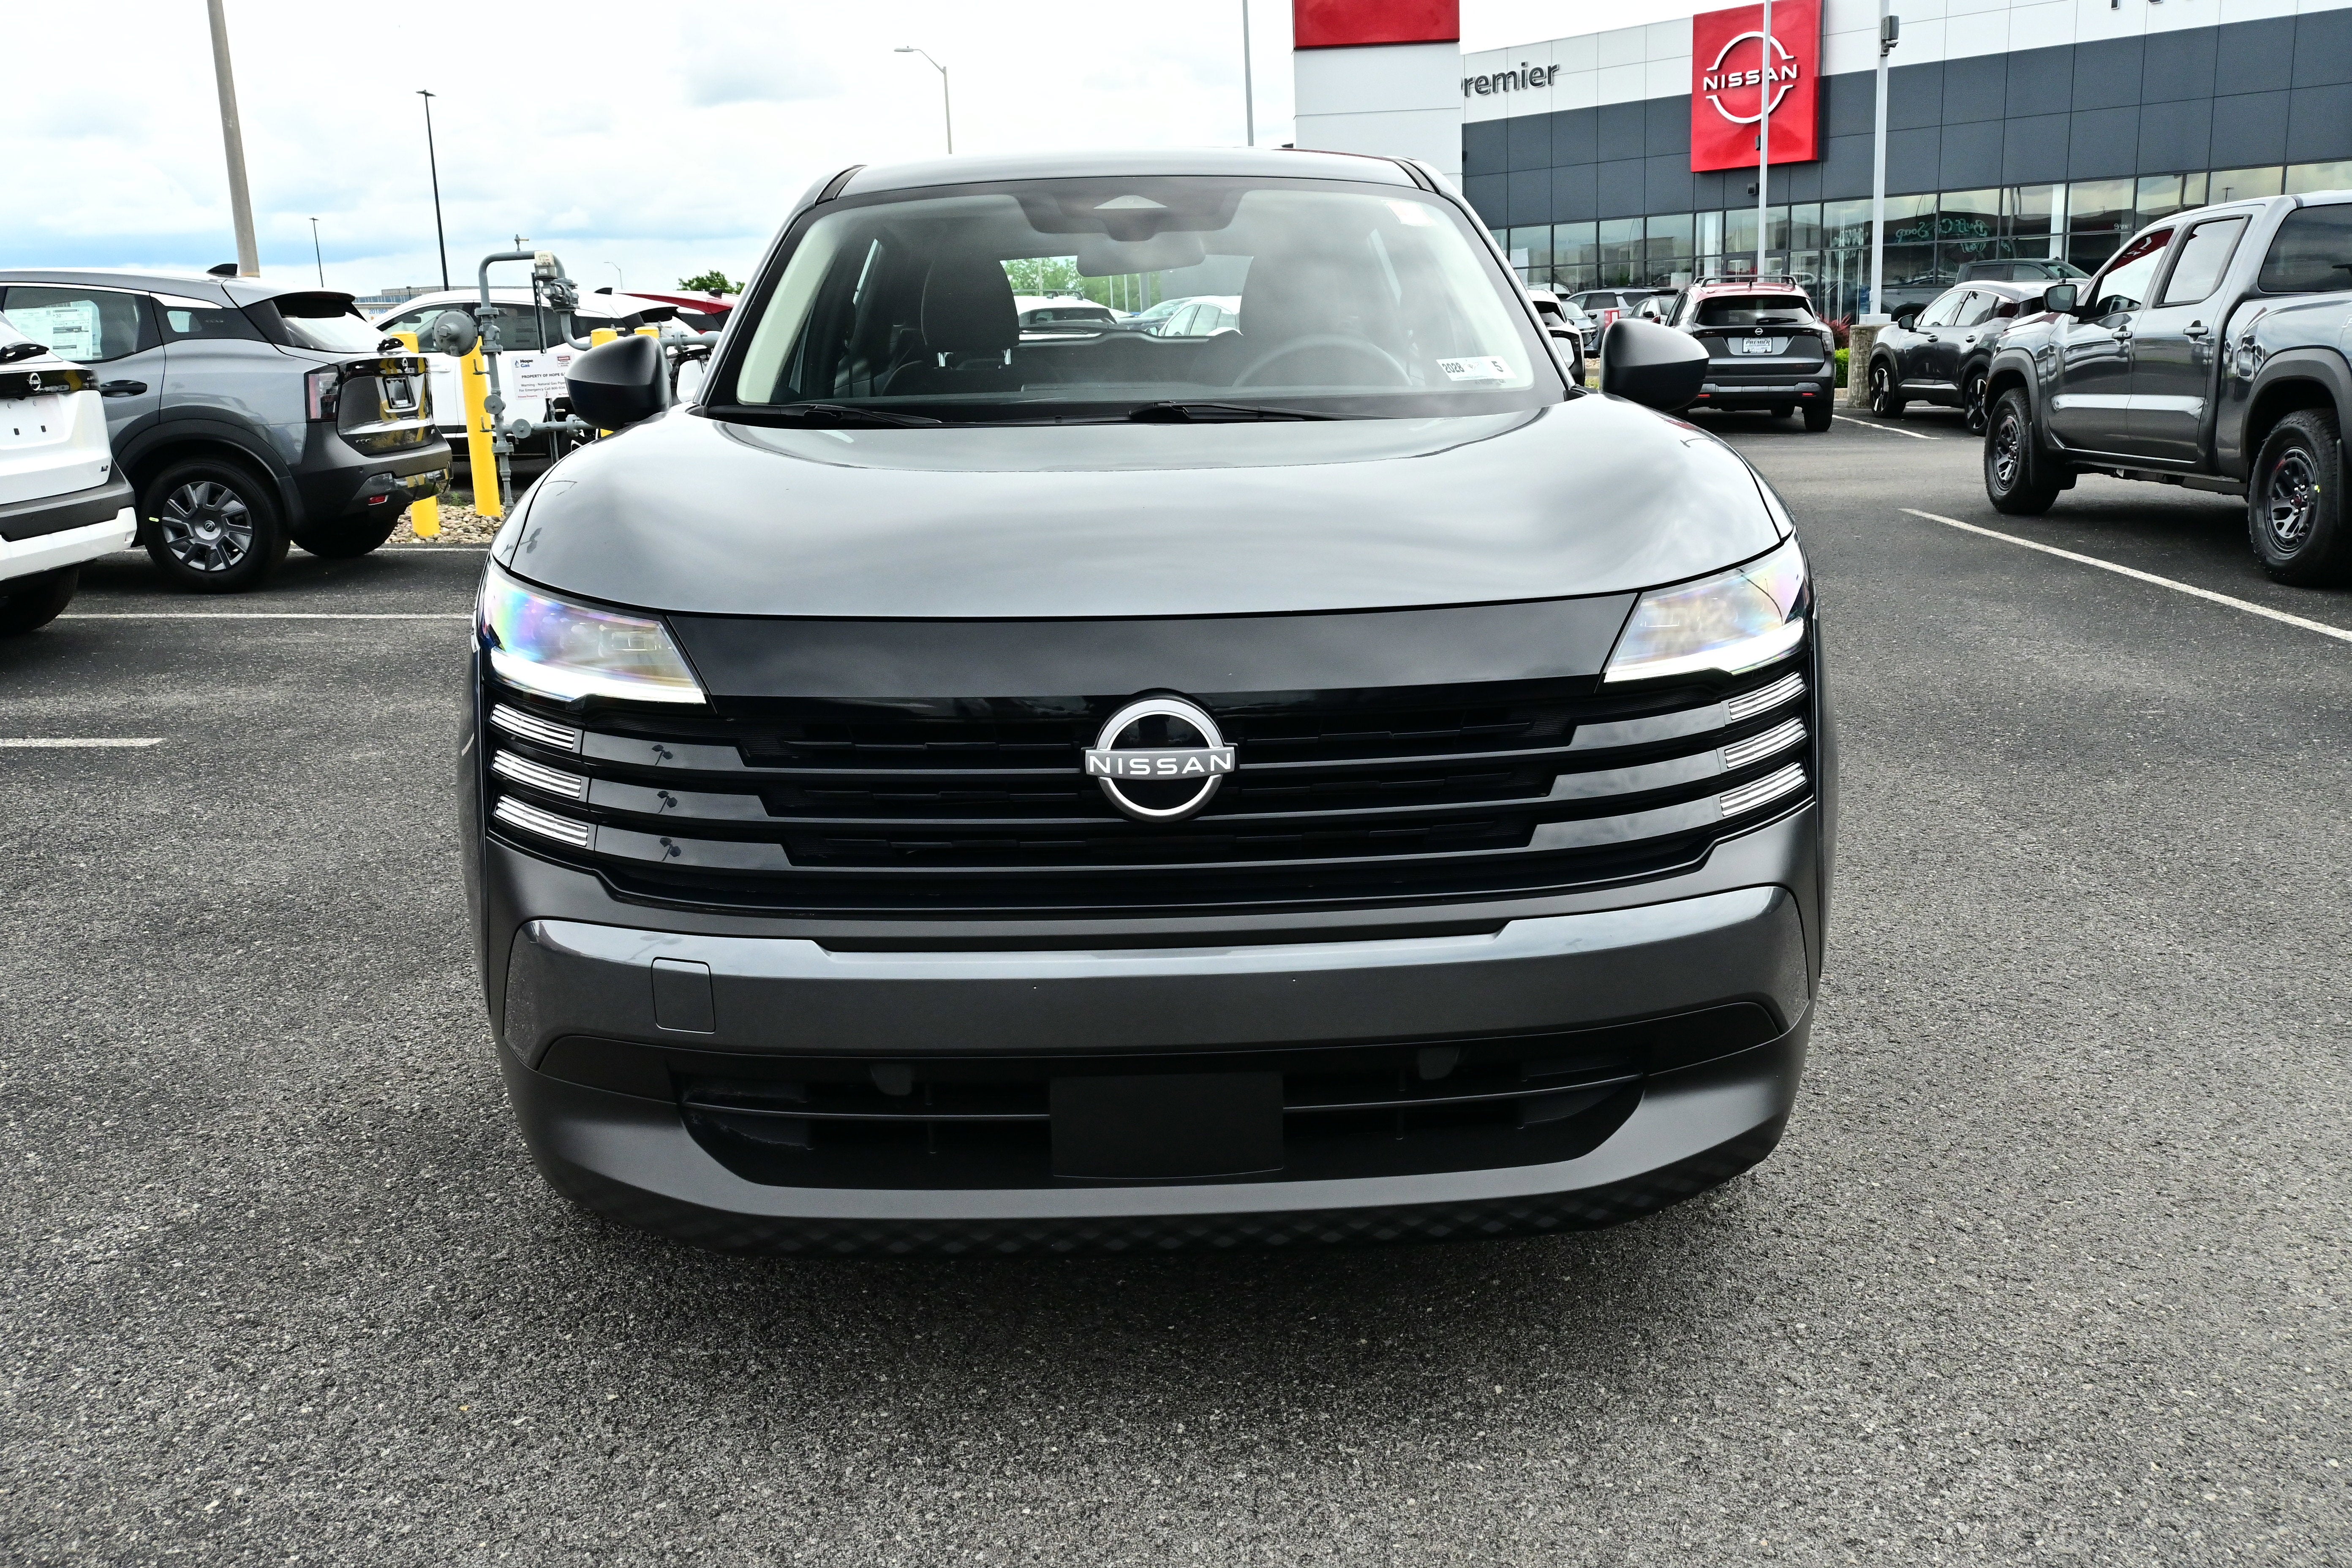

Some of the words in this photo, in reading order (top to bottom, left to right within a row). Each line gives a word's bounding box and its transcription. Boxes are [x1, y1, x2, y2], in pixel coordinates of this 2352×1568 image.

[1461, 61, 1559, 97] remier
[1703, 64, 1797, 91] NISSAN
[1442, 362, 1465, 373] 2028
[1491, 361, 1503, 372] 5
[1089, 752, 1231, 775] NISSAN
